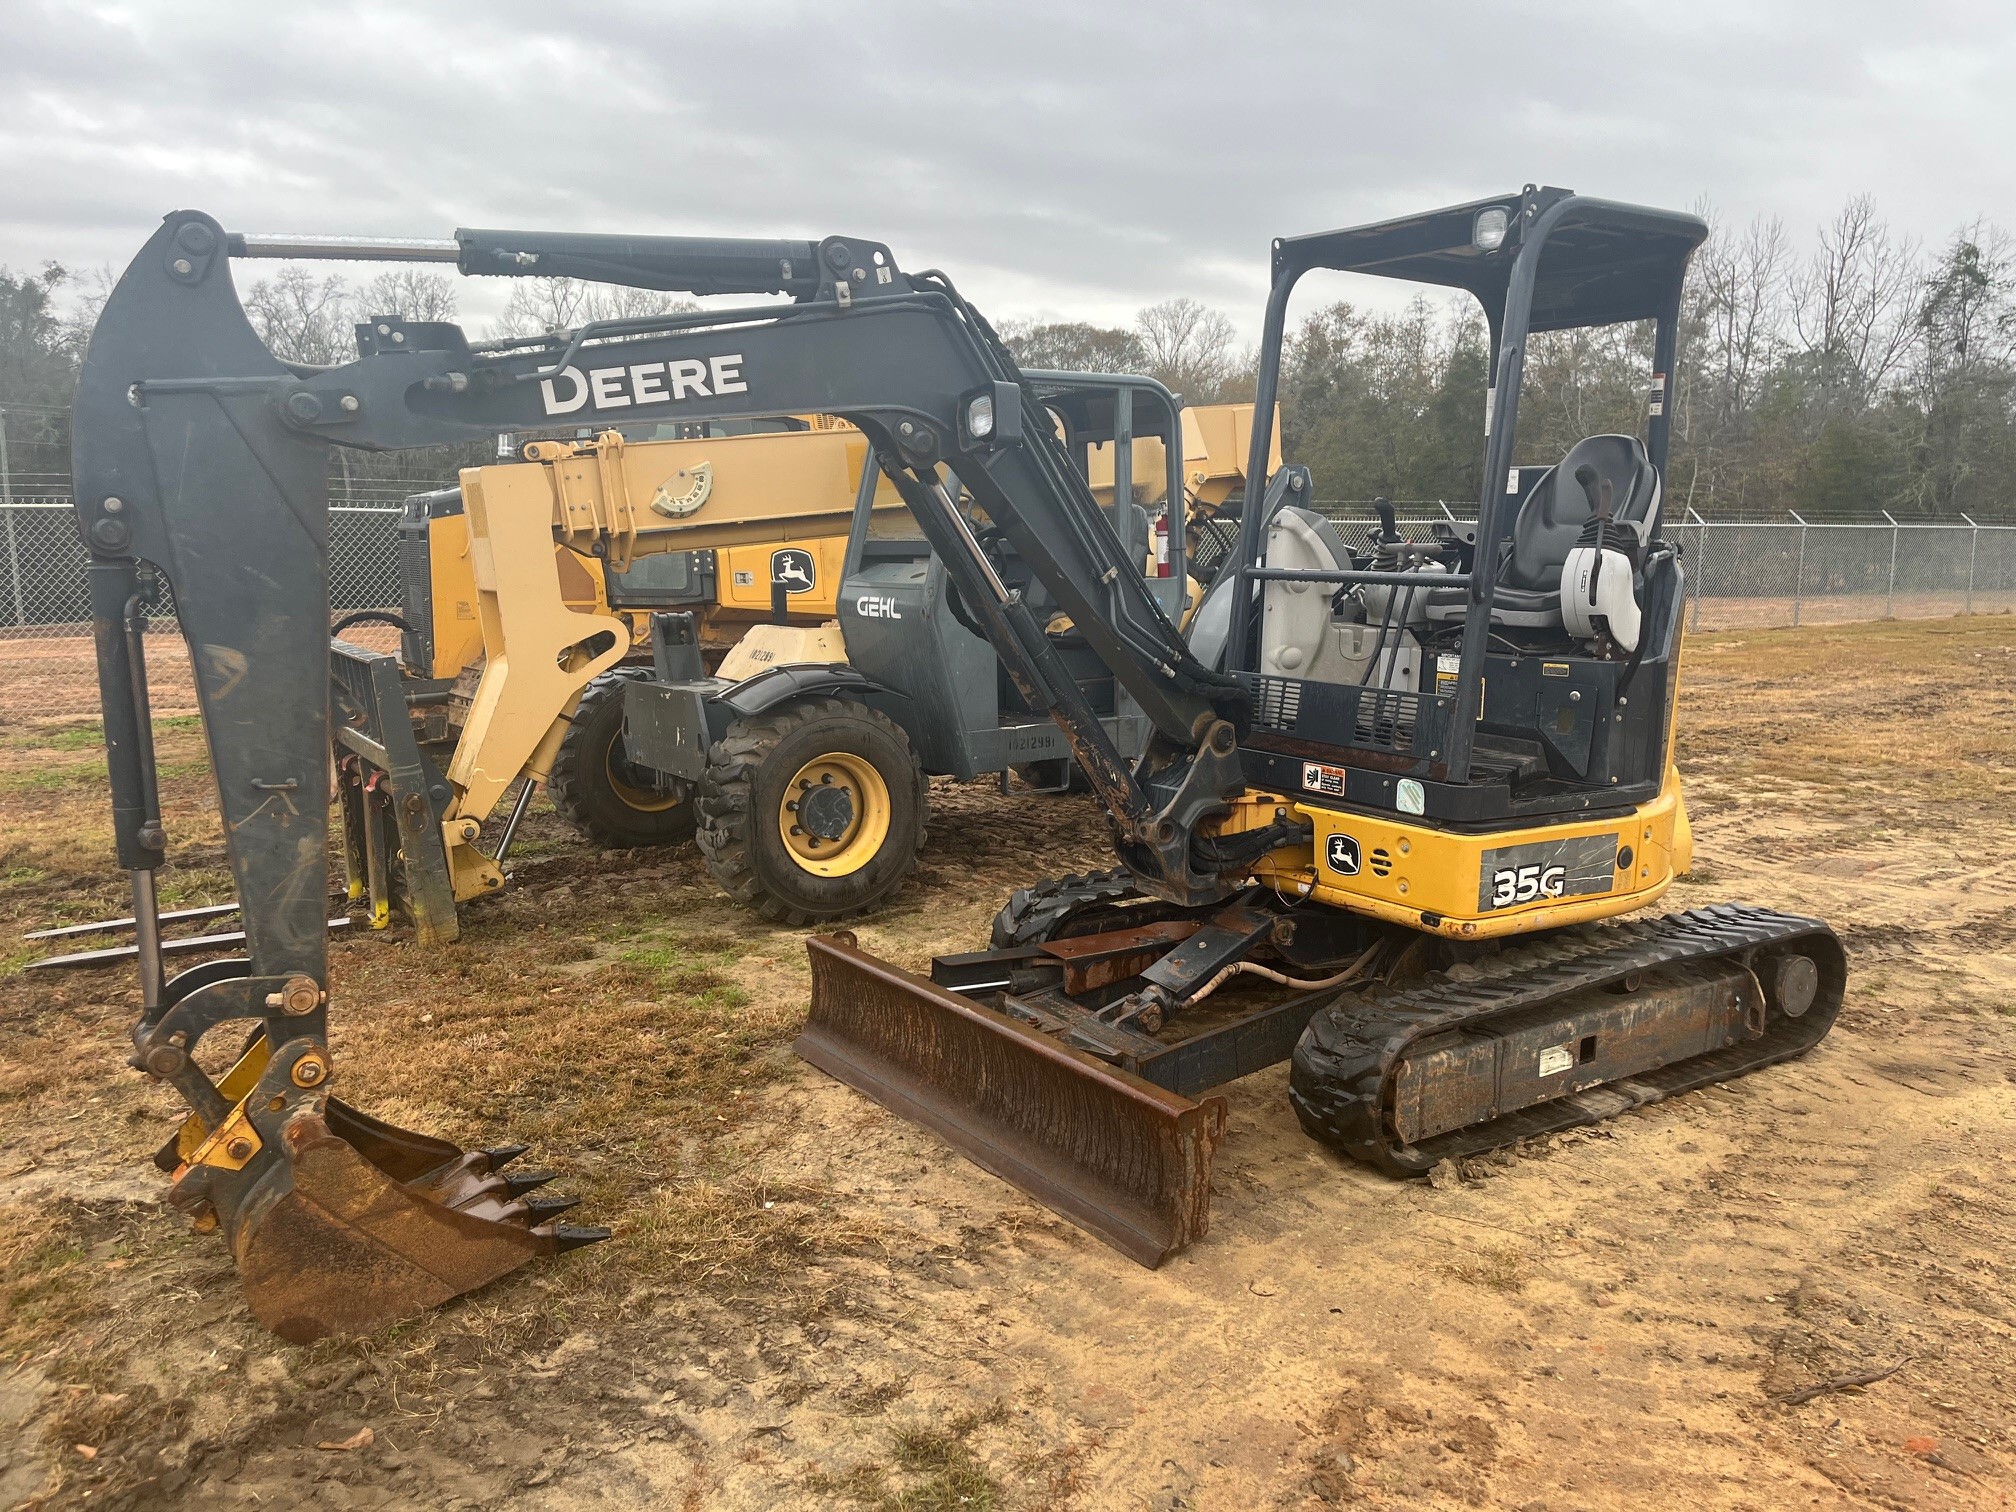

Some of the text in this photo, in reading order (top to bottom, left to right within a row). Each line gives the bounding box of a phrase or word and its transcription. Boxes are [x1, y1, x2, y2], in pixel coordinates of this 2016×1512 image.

[537, 354, 748, 415] DEERE
[856, 596, 902, 619] GEHL
[1491, 864, 1566, 908] 35G
